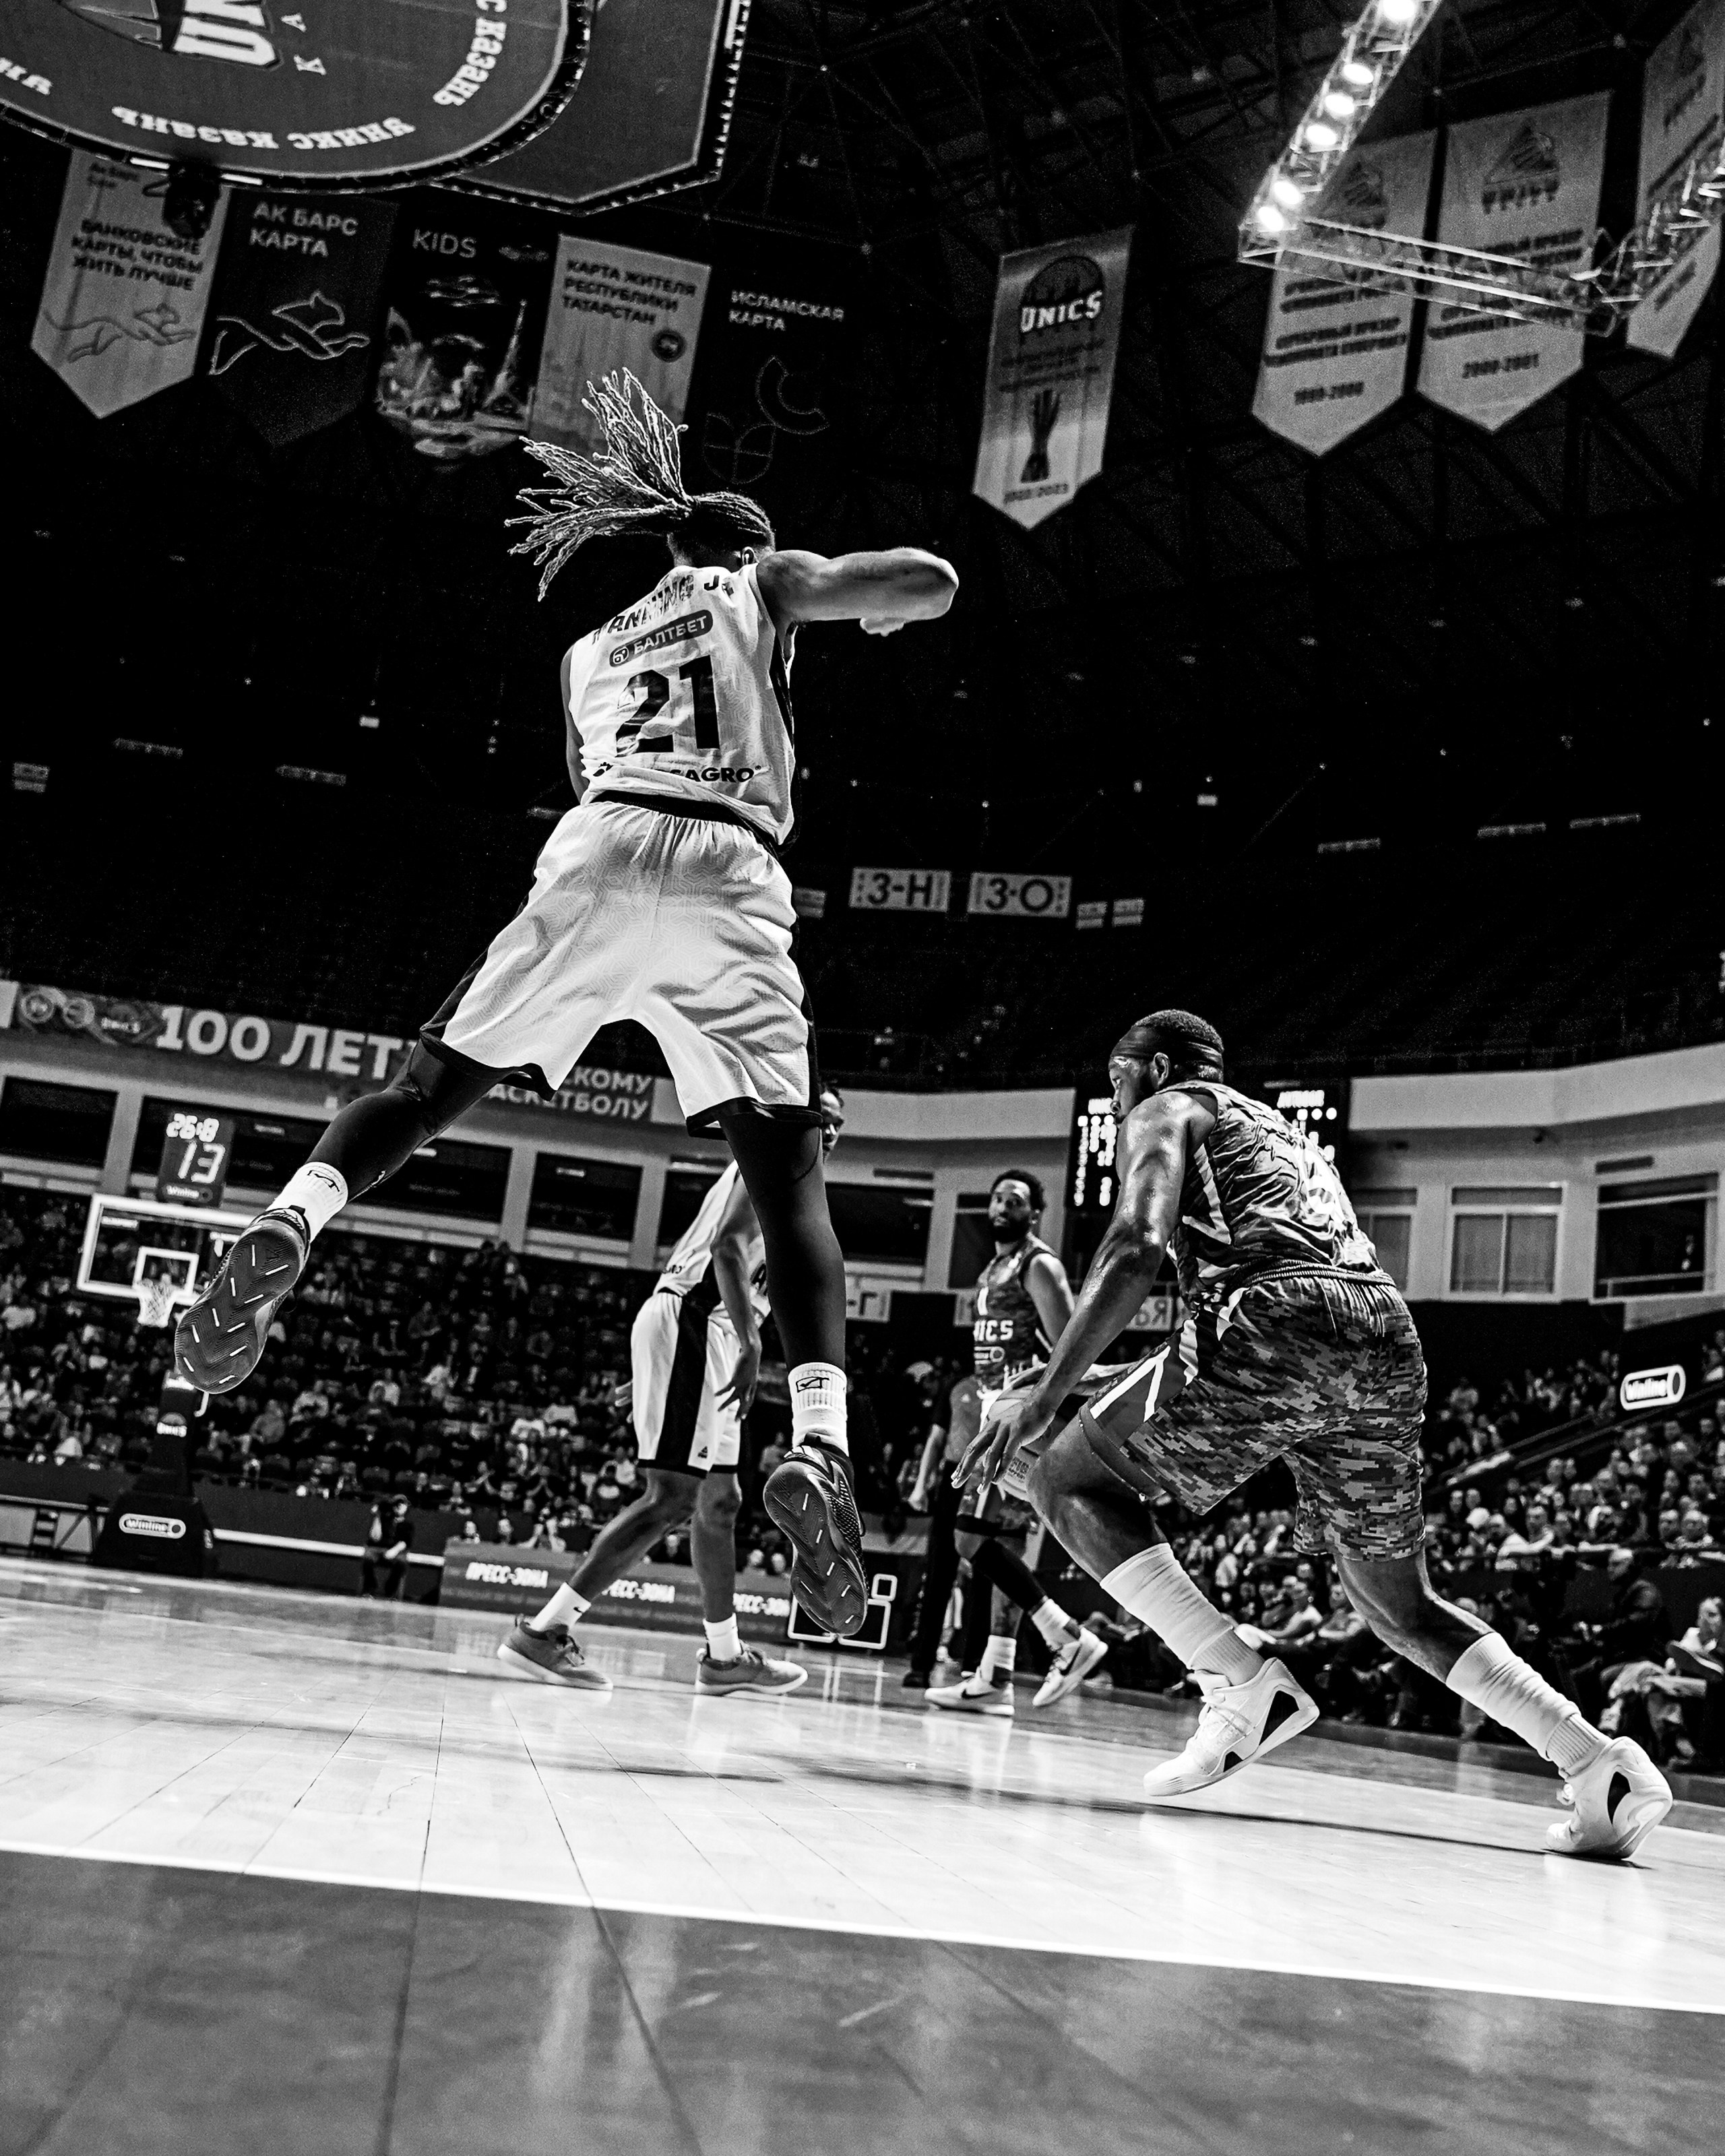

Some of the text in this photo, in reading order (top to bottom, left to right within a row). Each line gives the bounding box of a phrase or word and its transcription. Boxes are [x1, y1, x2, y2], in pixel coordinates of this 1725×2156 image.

[253, 201, 359, 236] АК БАРС
[249, 227, 330, 258] КАРТА
[411, 228, 476, 259] KIDS
[563, 277, 679, 312] РЕСПУБЛИКИ
[565, 259, 698, 298] КАРТА ЖИТЕЛЯ
[562, 295, 658, 325] ТАТАРСТАН
[728, 309, 786, 331] КАРТА
[730, 288, 846, 322] ИСЛАМСКАЯ
[1020, 290, 1104, 333] UNICS
[633, 614, 708, 654] БАЛТБЕТ
[615, 654, 721, 758] 21
[156, 1005, 403, 1079] 100 ЛЕТ
[177, 1141, 226, 1182] 13
[466, 1560, 548, 1589] ПРЕСС-ЗОНА
